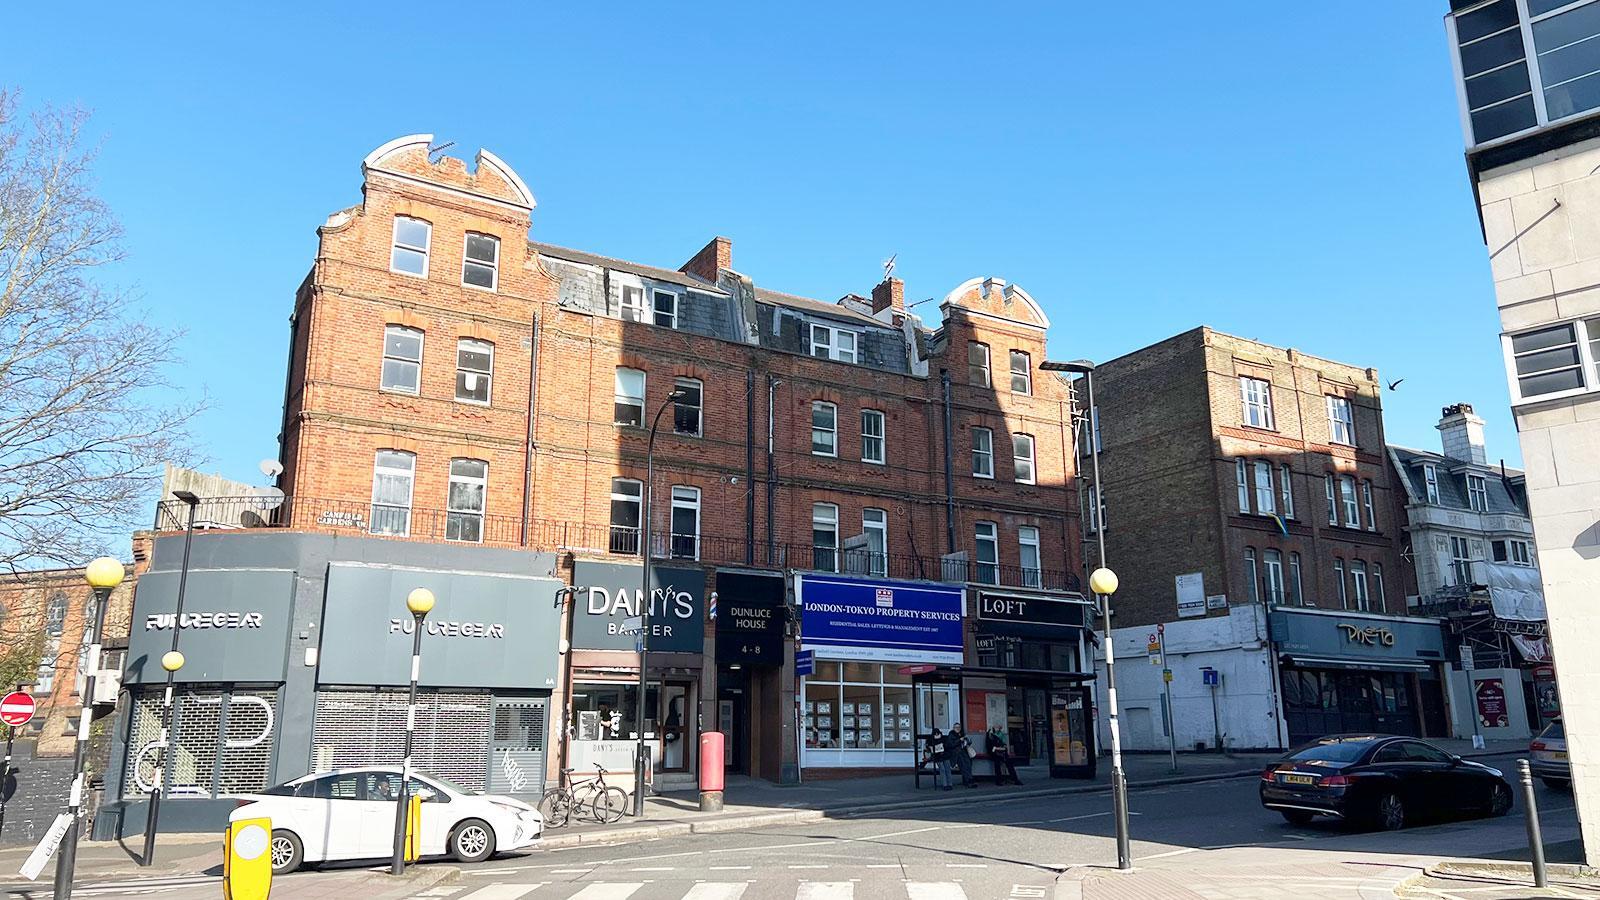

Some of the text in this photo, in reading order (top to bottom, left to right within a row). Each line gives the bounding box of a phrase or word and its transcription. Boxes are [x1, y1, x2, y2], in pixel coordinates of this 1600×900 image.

[322, 511, 363, 521] CANFIELD
[316, 518, 353, 526] GARDENS
[587, 585, 694, 619] DANY'S
[984, 599, 1027, 615] LOFT
[731, 607, 771, 618] DUNLUCE
[805, 602, 960, 621] LONDON-TOKYO PROPERTY SERVICES
[390, 618, 504, 638] FUUREGEAR
[736, 619, 766, 629] HOUSE
[976, 640, 993, 648] LOFT
[742, 645, 747, 653] 4
[755, 646, 761, 654] 8
